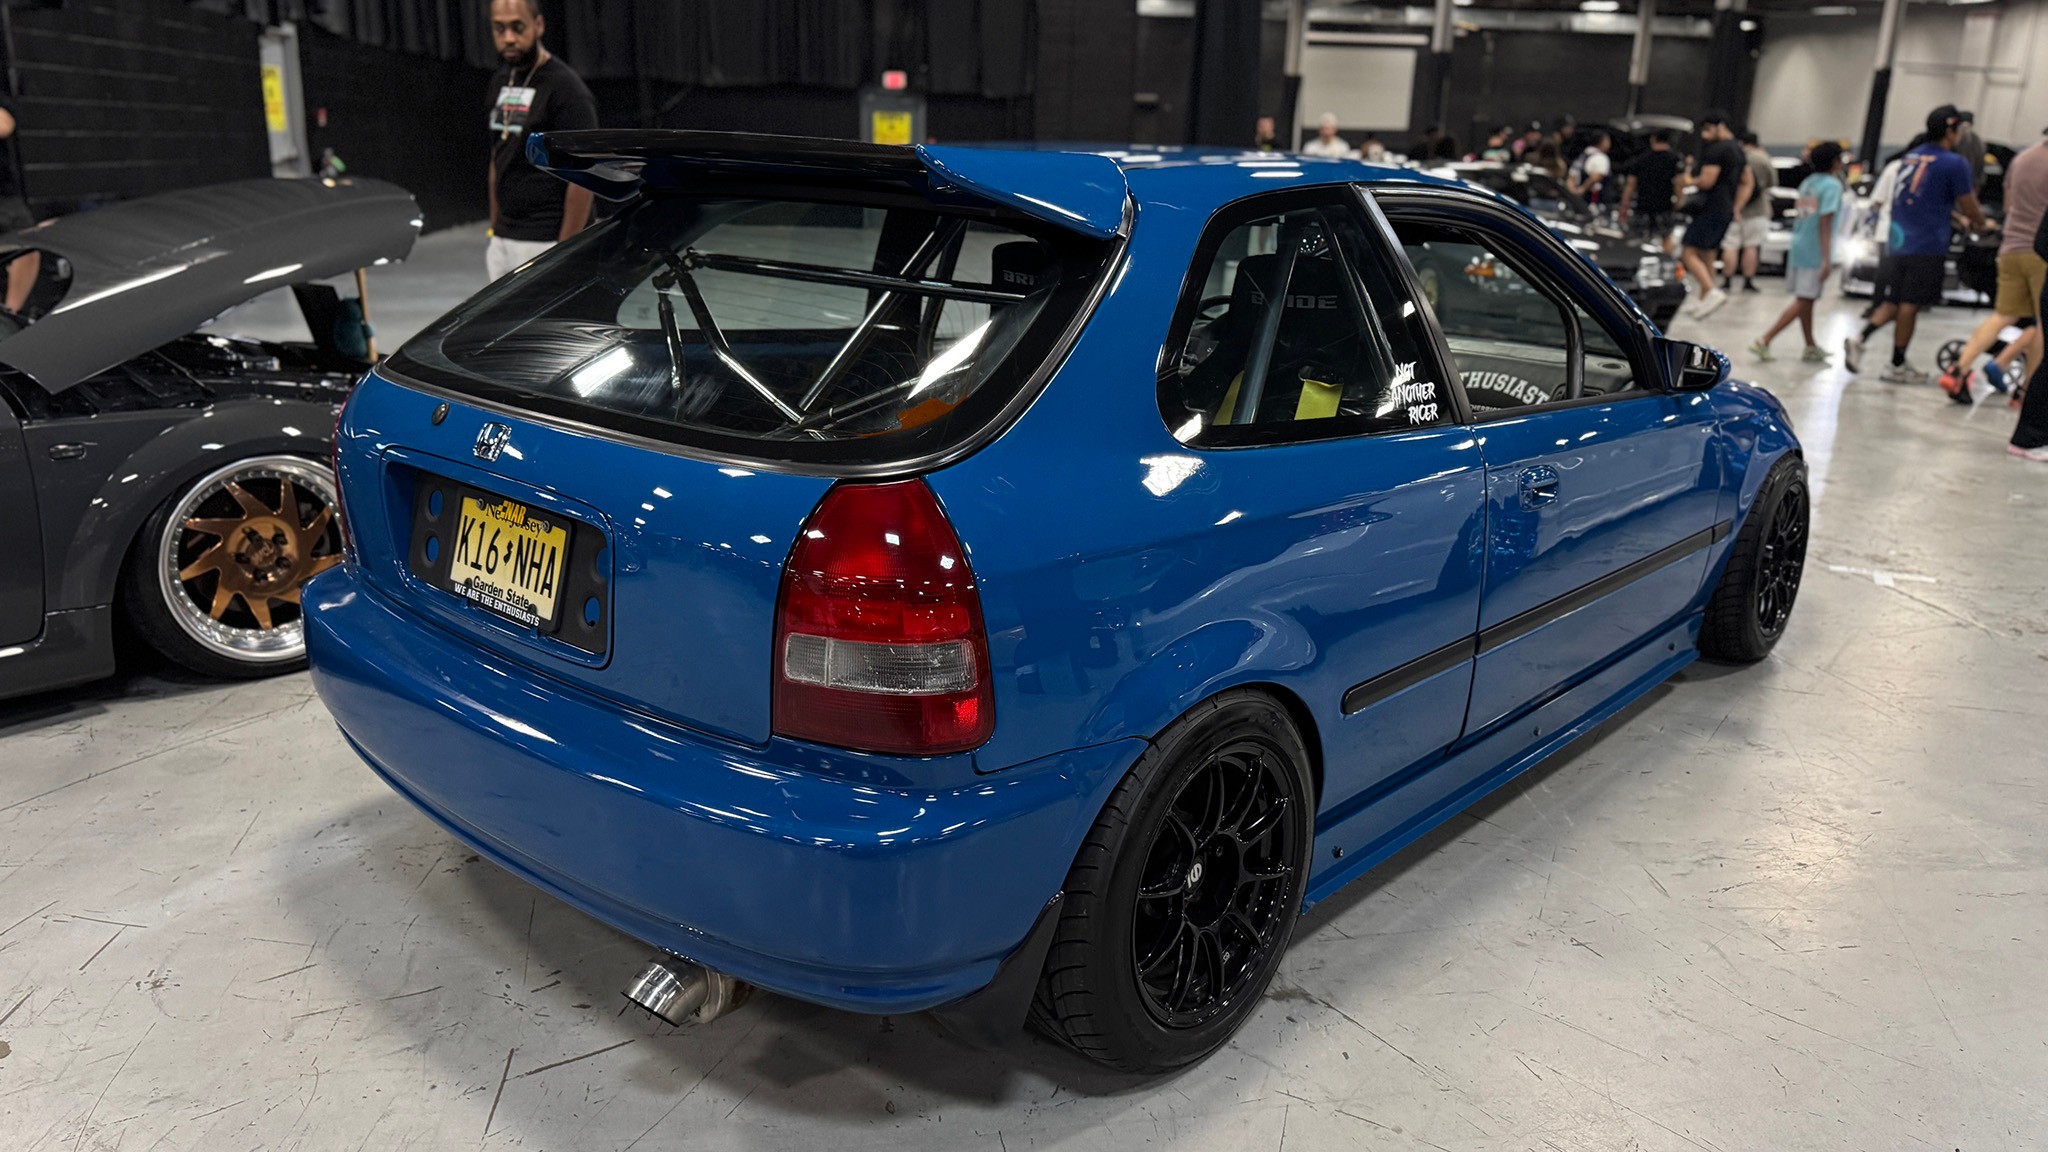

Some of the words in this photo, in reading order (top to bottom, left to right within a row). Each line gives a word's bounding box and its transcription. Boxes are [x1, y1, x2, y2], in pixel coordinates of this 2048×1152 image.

[1002, 269, 1035, 286] BRI
[1250, 290, 1338, 310] BIDE
[1395, 361, 1417, 381] NOT
[1392, 382, 1436, 409] ANOTHER
[1408, 403, 1439, 425] RICER
[473, 576, 504, 598] Garden
[506, 588, 529, 609] State
[454, 583, 467, 596] WE
[466, 588, 480, 601] ARE
[480, 594, 494, 607] THE
[493, 600, 540, 627] ENTHUSIASTS
